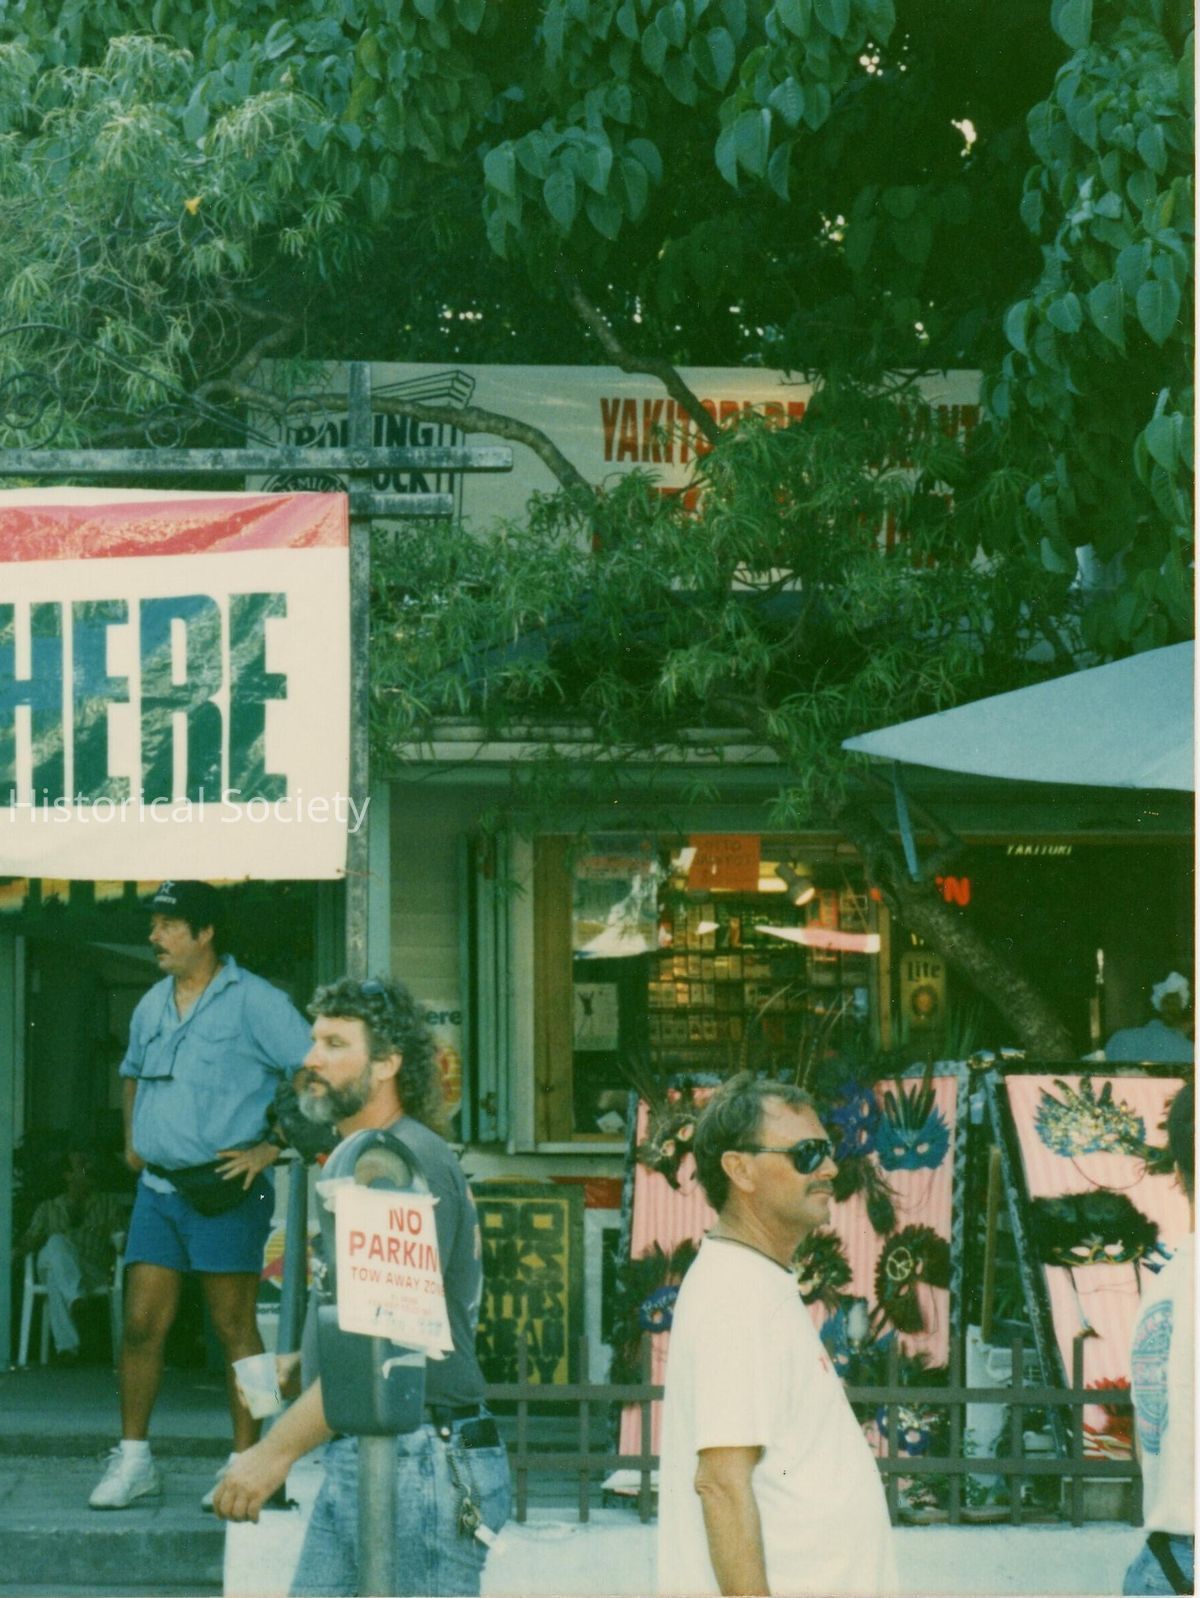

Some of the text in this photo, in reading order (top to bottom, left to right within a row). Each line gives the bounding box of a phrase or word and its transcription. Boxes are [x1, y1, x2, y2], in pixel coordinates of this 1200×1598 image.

[389, 1207, 423, 1236] NO
[349, 1230, 439, 1273] PARKIN
[352, 1266, 381, 1283] TOW
[385, 1271, 420, 1290] AWAY
